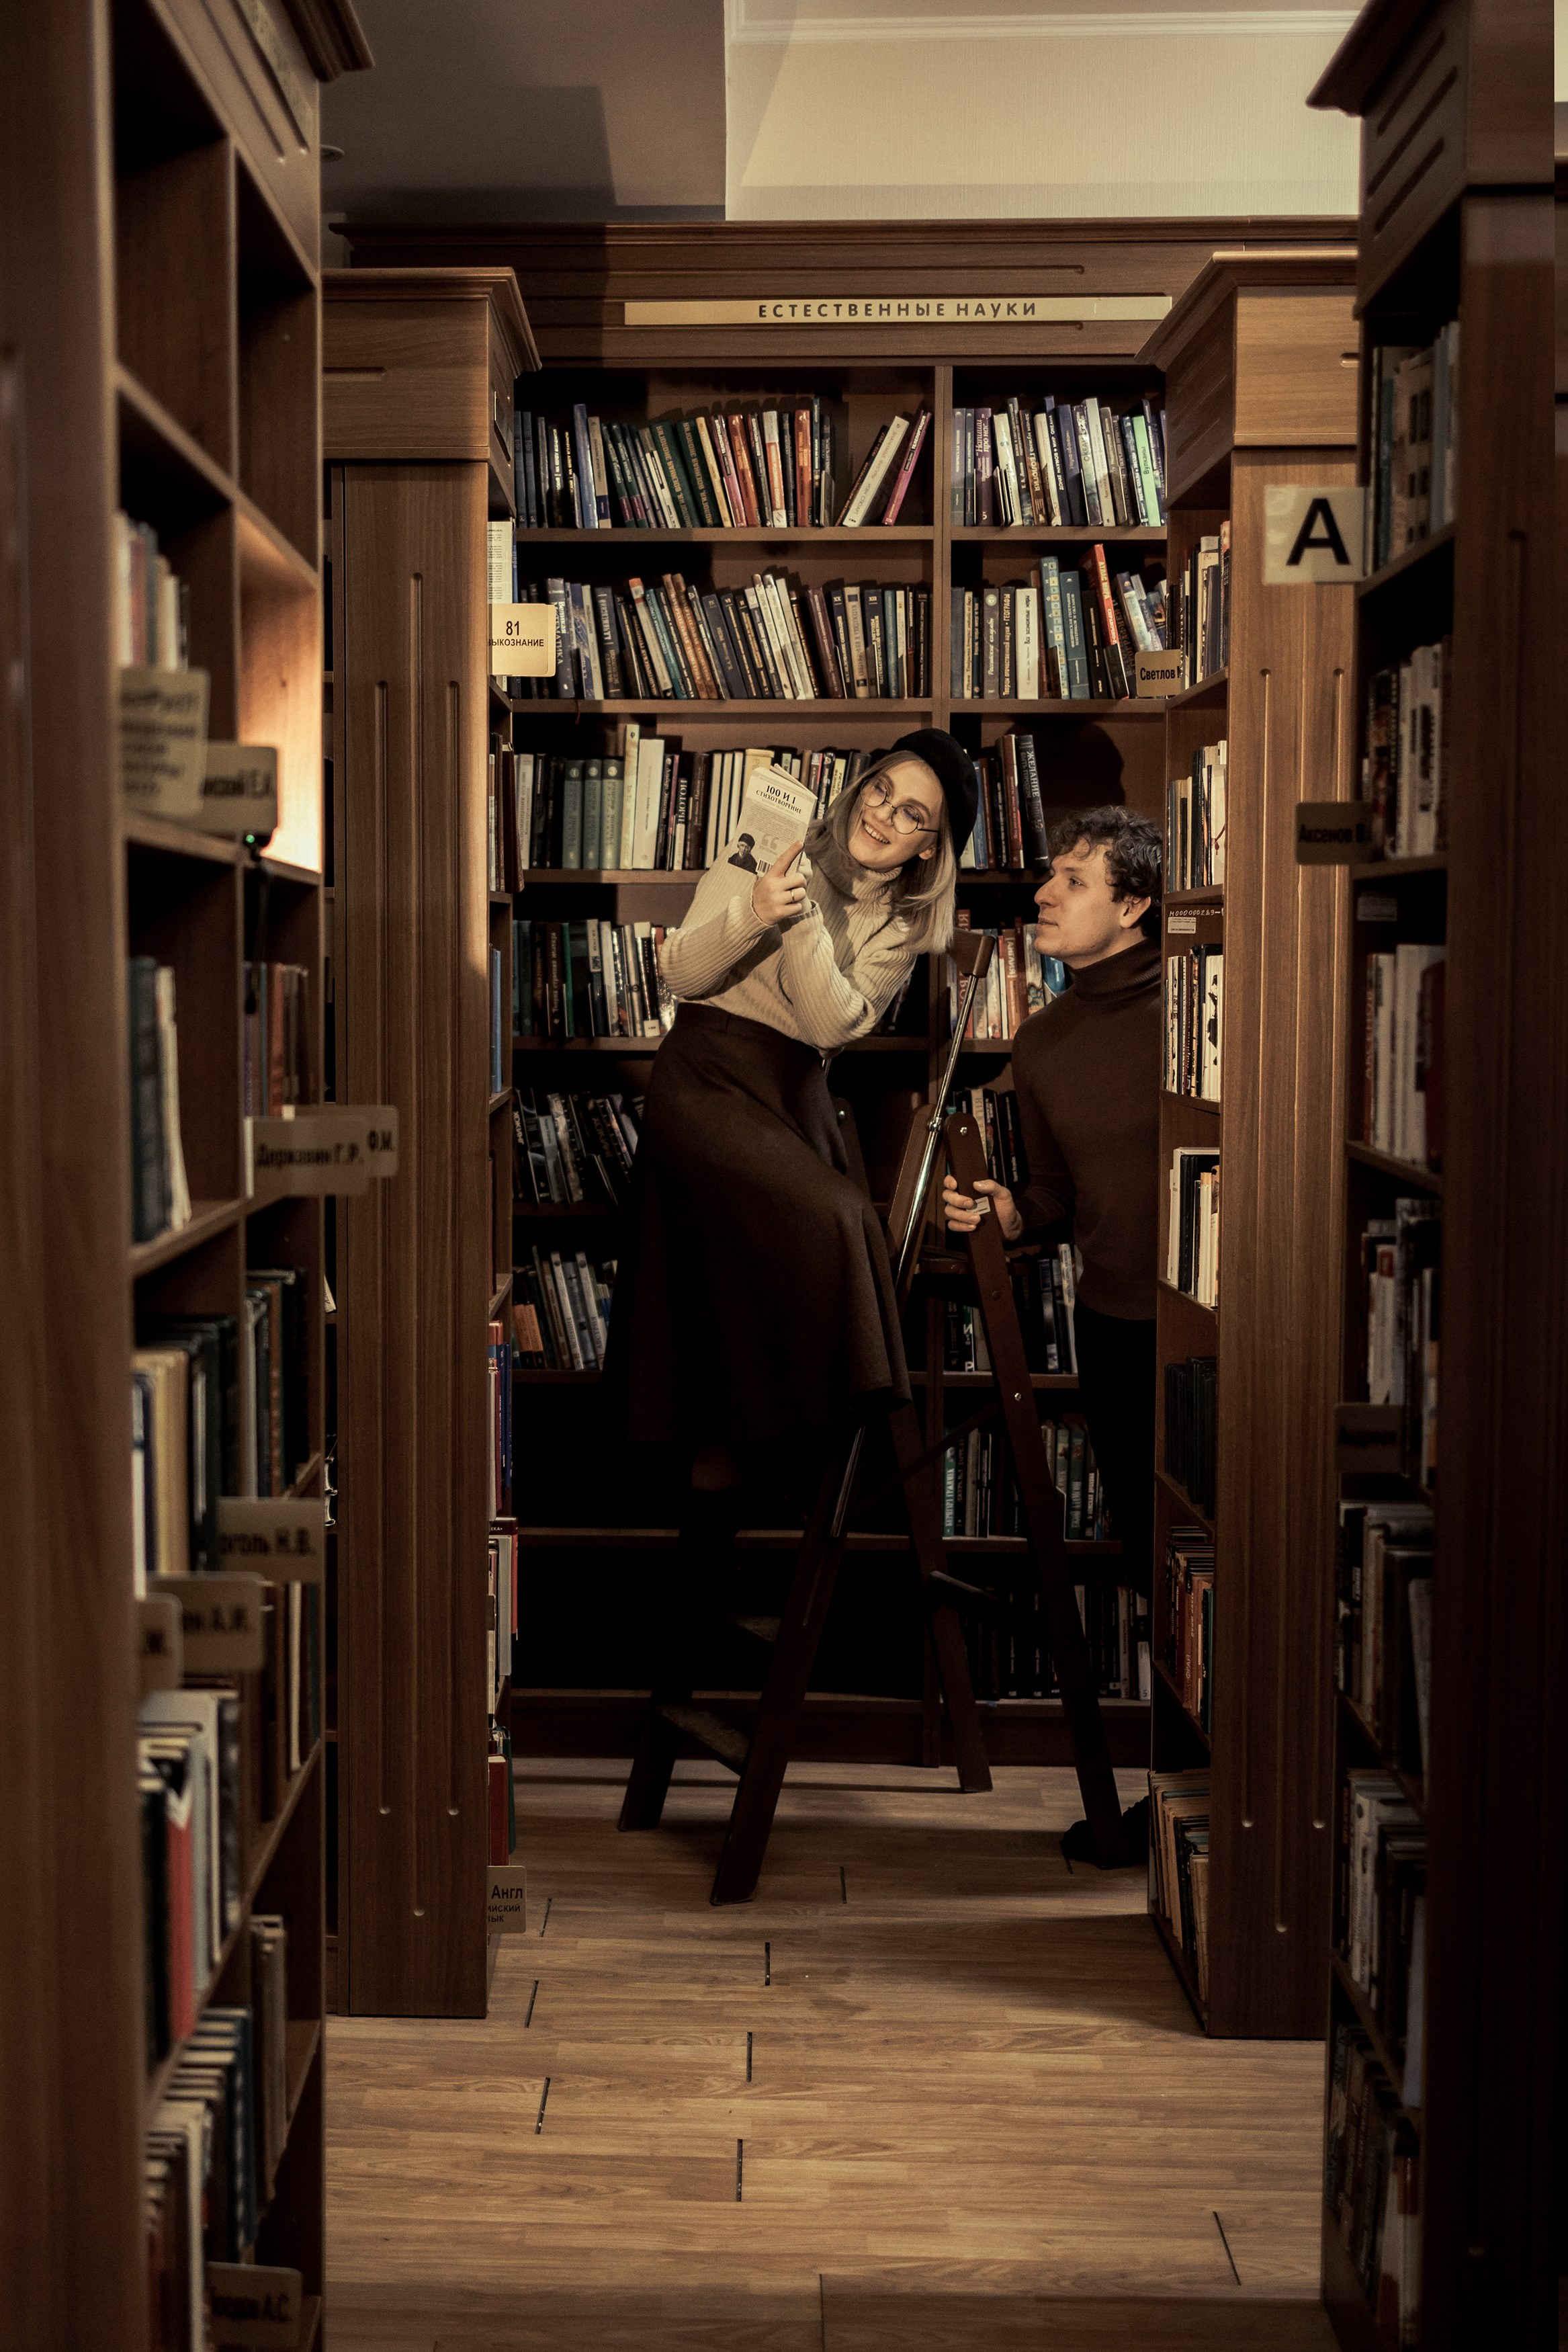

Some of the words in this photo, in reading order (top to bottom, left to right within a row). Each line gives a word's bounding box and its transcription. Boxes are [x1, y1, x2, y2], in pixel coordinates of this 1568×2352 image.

[758, 303, 945, 318] ЕСТЕСТВЕННЫЕ
[956, 302, 1037, 318] НАУКИ
[658, 425, 672, 460] ЭКОЛОГИЯ
[683, 422, 697, 457] ЭКОЛОГИЯ
[911, 415, 926, 450] ТЕЛЕПОРТАЦИЯ
[692, 457, 705, 489] ВОЕННАЯ
[1029, 452, 1041, 491] ГЕОЛОГИЯ
[1141, 446, 1149, 474] Вулканы
[668, 461, 682, 492] ВОЕННАЯ
[1286, 497, 1350, 566] А
[1098, 561, 1106, 581] АТЛАС
[1102, 582, 1110, 600] МИРА
[558, 601, 566, 634] Великая
[646, 593, 657, 619] СТРОГОСТЬ
[506, 621, 521, 636] 81
[654, 619, 668, 654] СОВЕРШЕННАЯ
[1002, 677, 1011, 696] Творцы
[1140, 667, 1176, 681] Светлов
[1022, 769, 1031, 798] ГОРОДОМ
[1027, 750, 1040, 797] ЖЕЛАНИЕ
[677, 779, 688, 824] НЬЮТОН
[756, 790, 802, 814] СТИХОТВОРЕНИЕ
[767, 786, 781, 797] 100
[783, 792, 791, 801] И
[513, 1110, 525, 1146] ХОКИНГ
[591, 1316, 603, 1350] АВСТРИЯ
[491, 1885, 523, 1899] Англ
